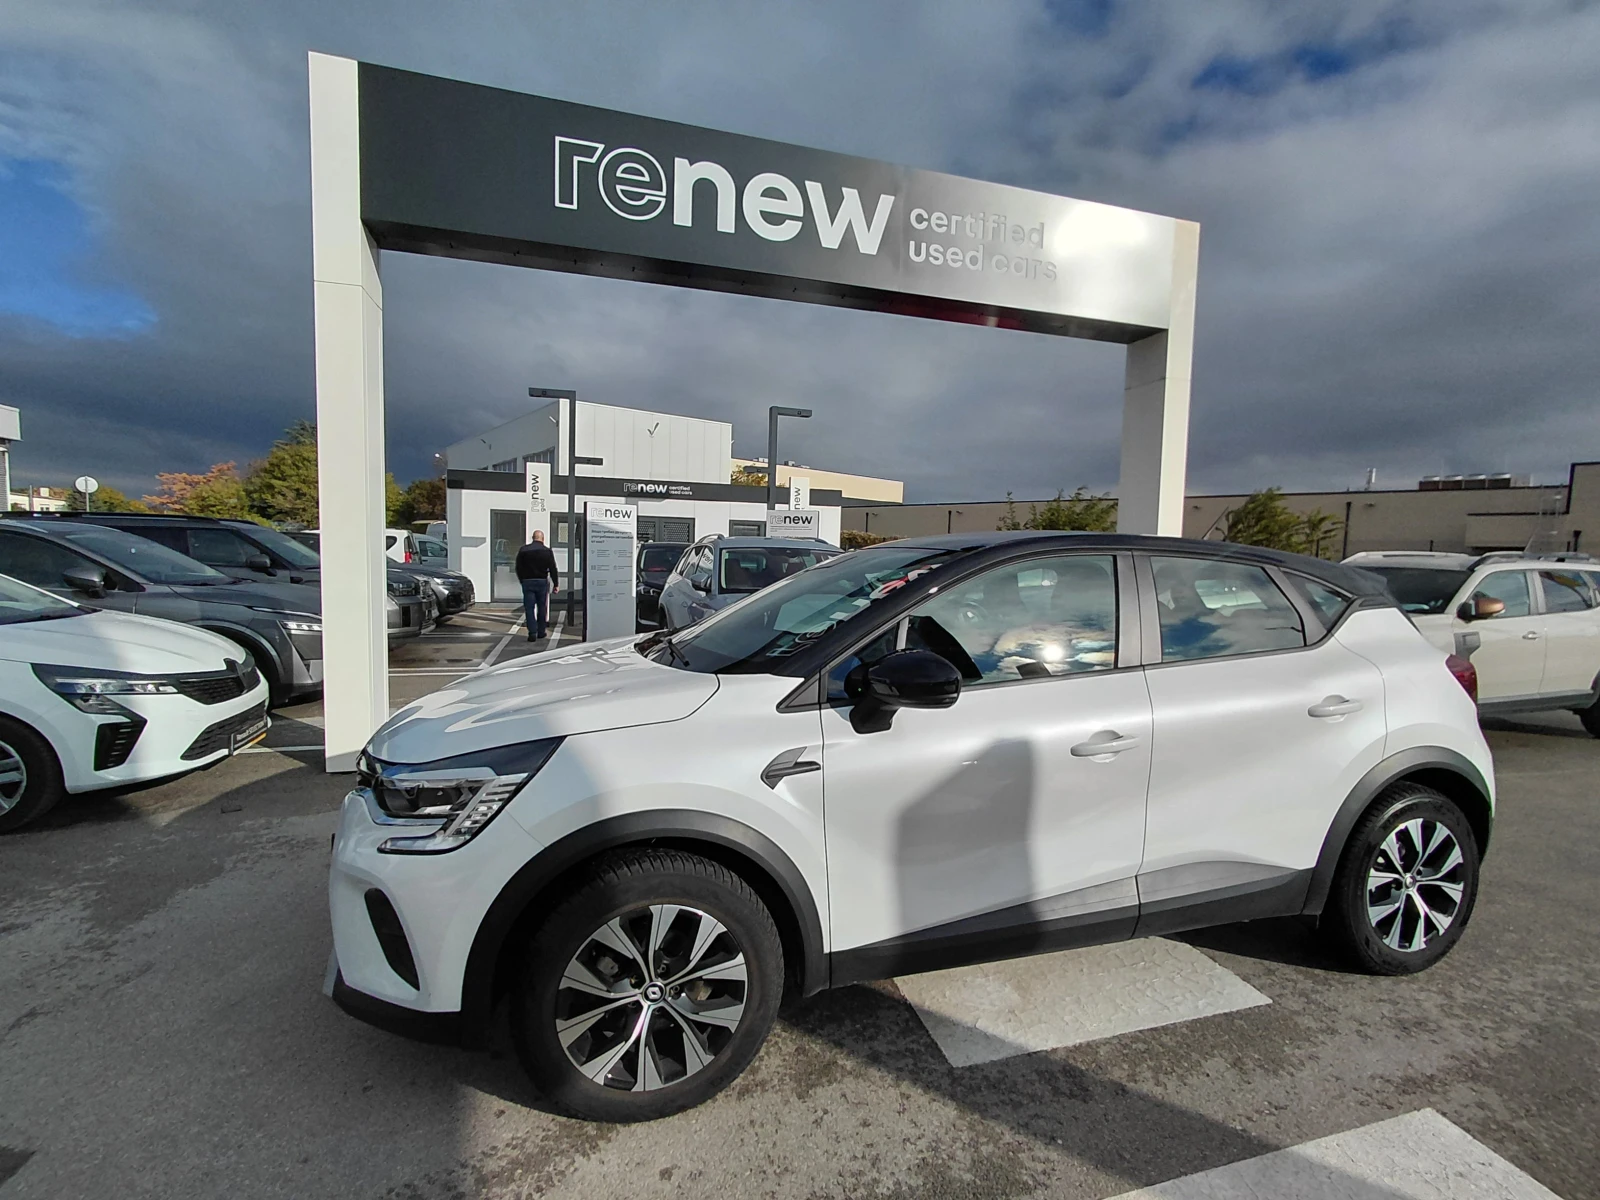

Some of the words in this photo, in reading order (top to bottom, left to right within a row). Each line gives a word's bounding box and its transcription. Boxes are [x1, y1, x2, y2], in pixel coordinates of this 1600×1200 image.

[554, 135, 896, 256] renew
[909, 207, 1045, 250] certified
[908, 240, 984, 272] used
[990, 252, 1058, 282] cars
[531, 473, 540, 513] renew
[623, 482, 668, 494] renew
[590, 507, 633, 519] renew
[769, 515, 813, 525] renew
